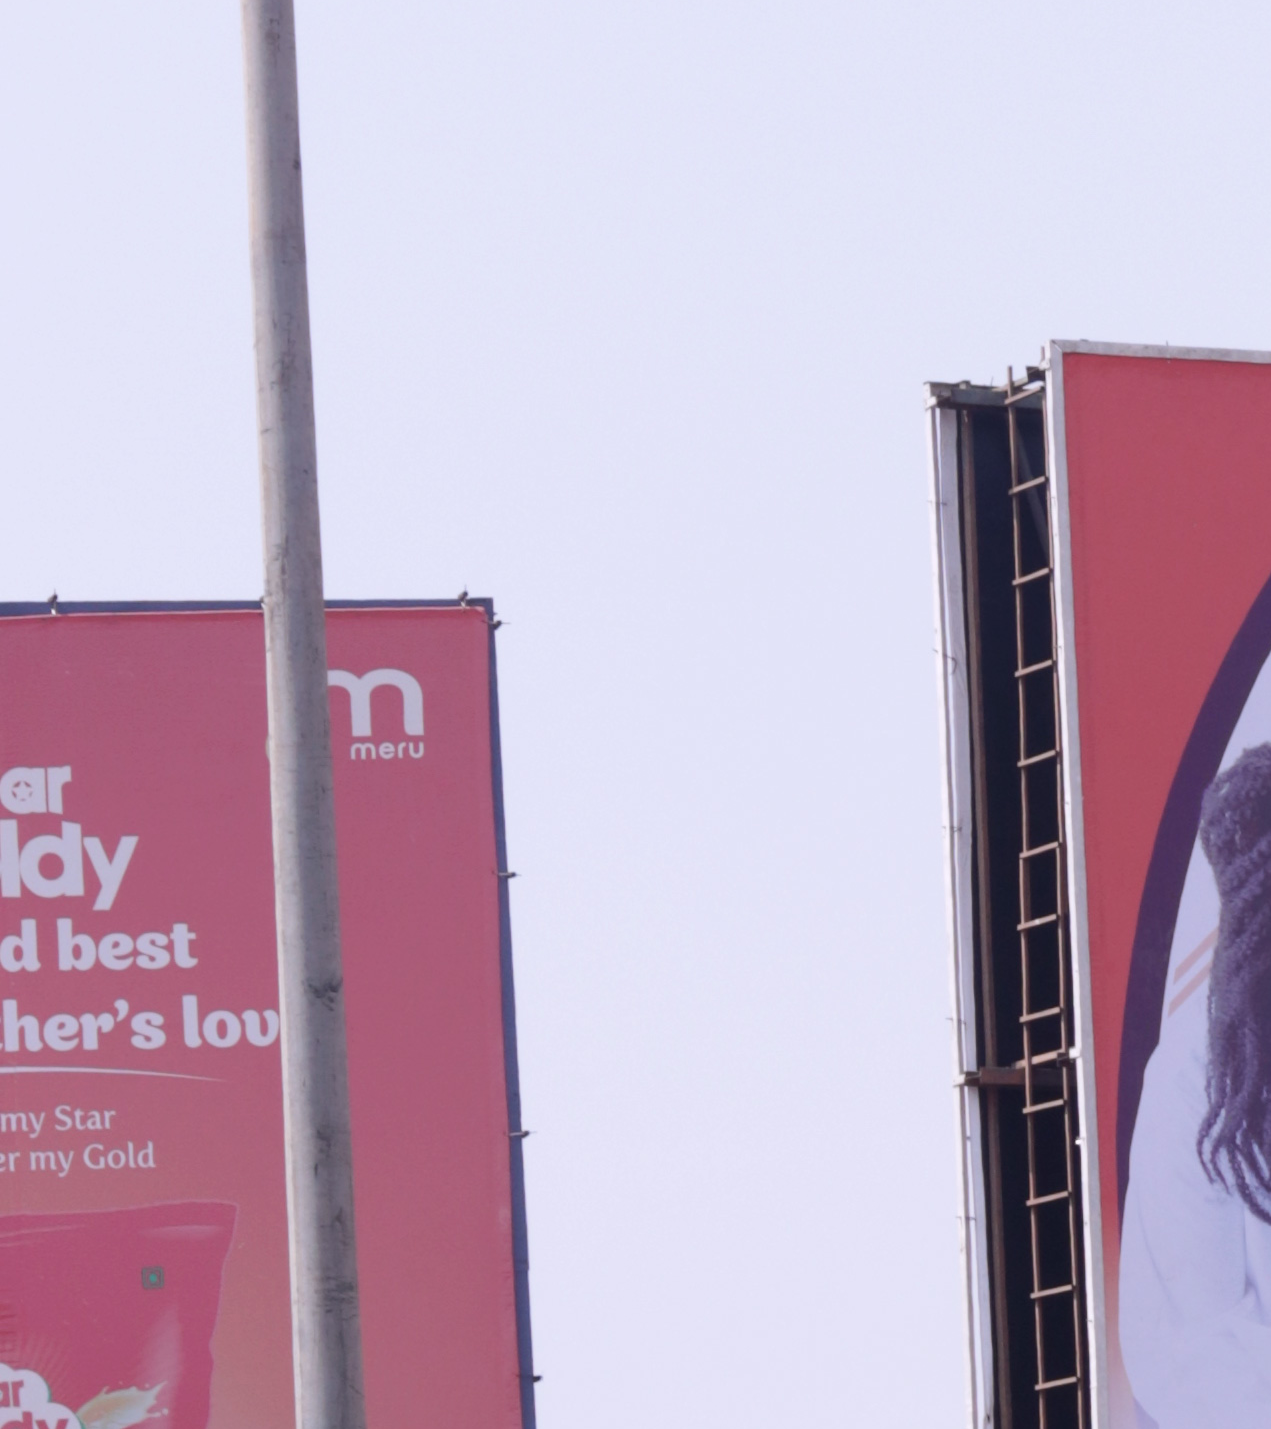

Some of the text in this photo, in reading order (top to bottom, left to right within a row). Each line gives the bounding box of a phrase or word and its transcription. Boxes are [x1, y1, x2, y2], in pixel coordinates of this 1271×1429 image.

[350, 741, 424, 760] meru
[57, 917, 198, 971] best
[182, 994, 280, 1048] lov
[54, 1105, 116, 1131] Star
[30, 1141, 156, 1178] my Gold
